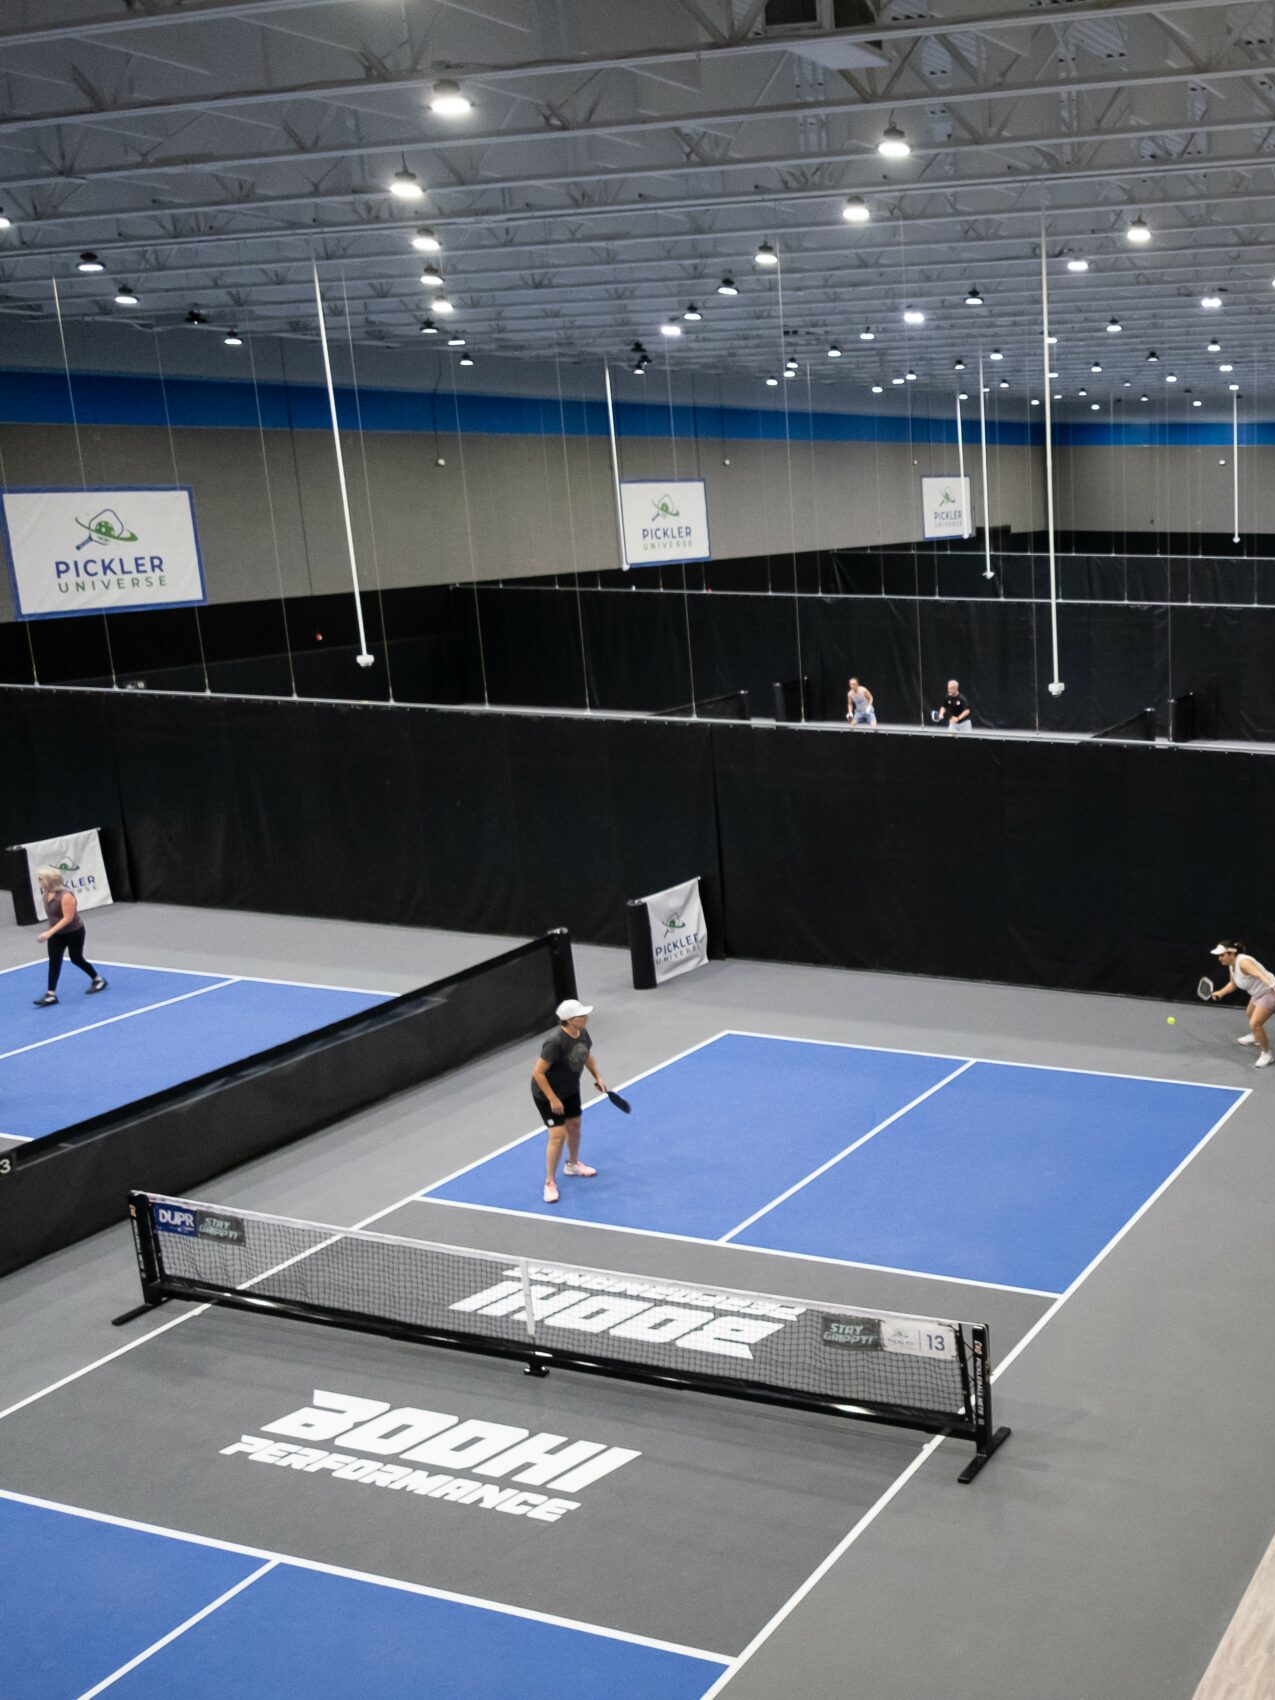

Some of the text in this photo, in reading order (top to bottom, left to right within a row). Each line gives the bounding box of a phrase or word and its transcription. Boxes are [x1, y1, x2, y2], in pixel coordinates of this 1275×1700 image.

[642, 526, 692, 540] PICKLER
[55, 556, 164, 579] PICKLER
[58, 575, 167, 593] UNIVERSE
[158, 1209, 195, 1227] DUPR
[205, 1217, 231, 1229] STAY
[823, 1330, 874, 1344] GRIPPY!
[830, 1322, 864, 1335] STAY
[926, 1334, 945, 1351] 13
[260, 1389, 642, 1493] BODHI
[219, 1434, 582, 1522] PERFORMANCE
